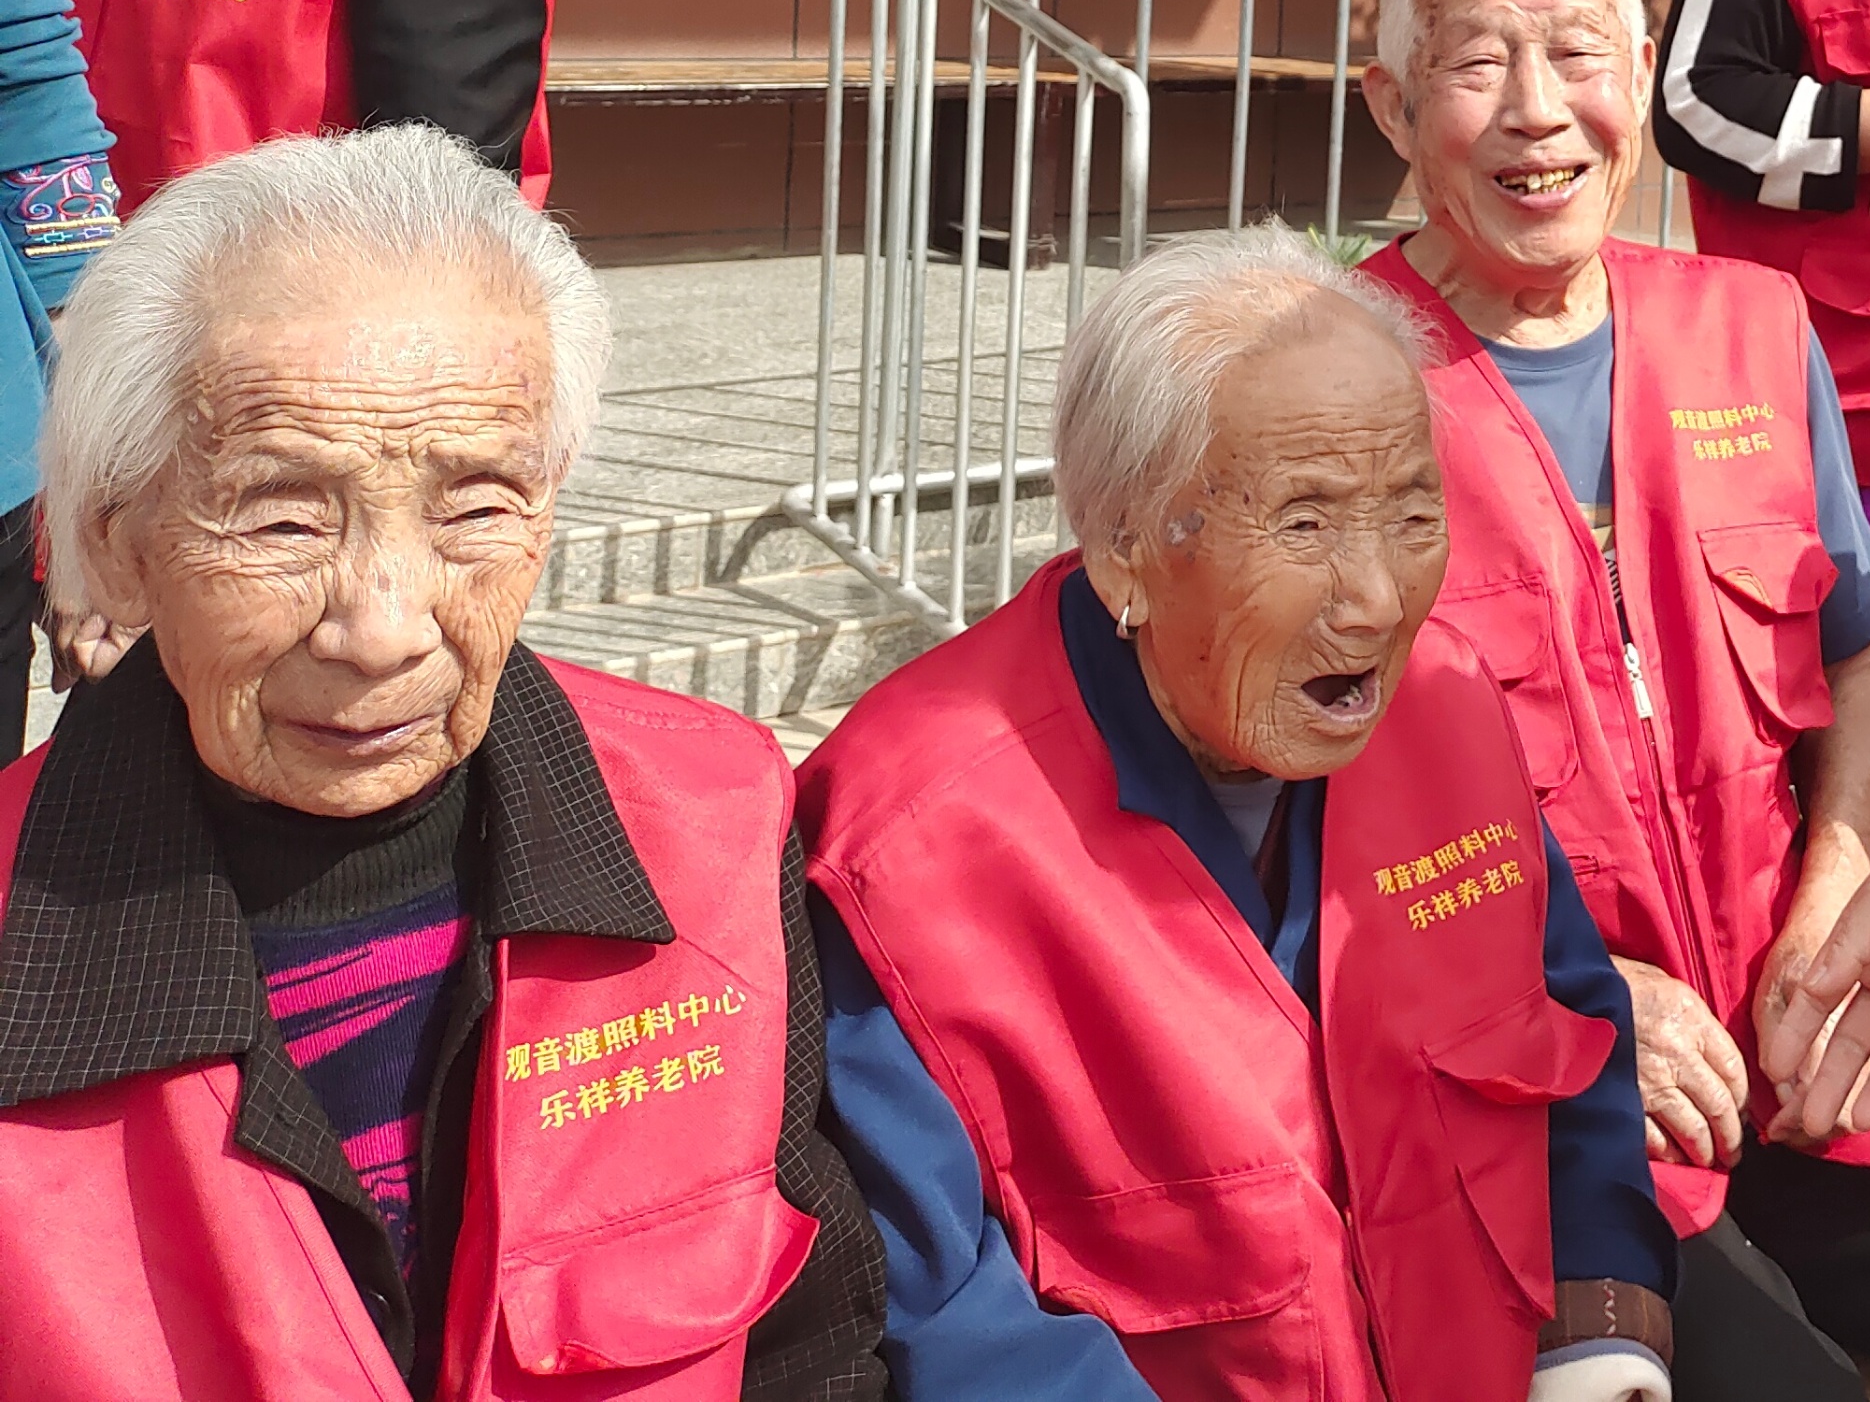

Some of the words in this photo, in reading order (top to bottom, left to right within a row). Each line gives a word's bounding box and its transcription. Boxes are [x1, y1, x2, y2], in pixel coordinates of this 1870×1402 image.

[1373, 818, 1519, 896] 观音渡照料中心
[1407, 860, 1524, 931] 乐祥养老院
[504, 984, 747, 1083] 观音渡照料中心
[539, 1044, 725, 1131] 乐祥养老院
